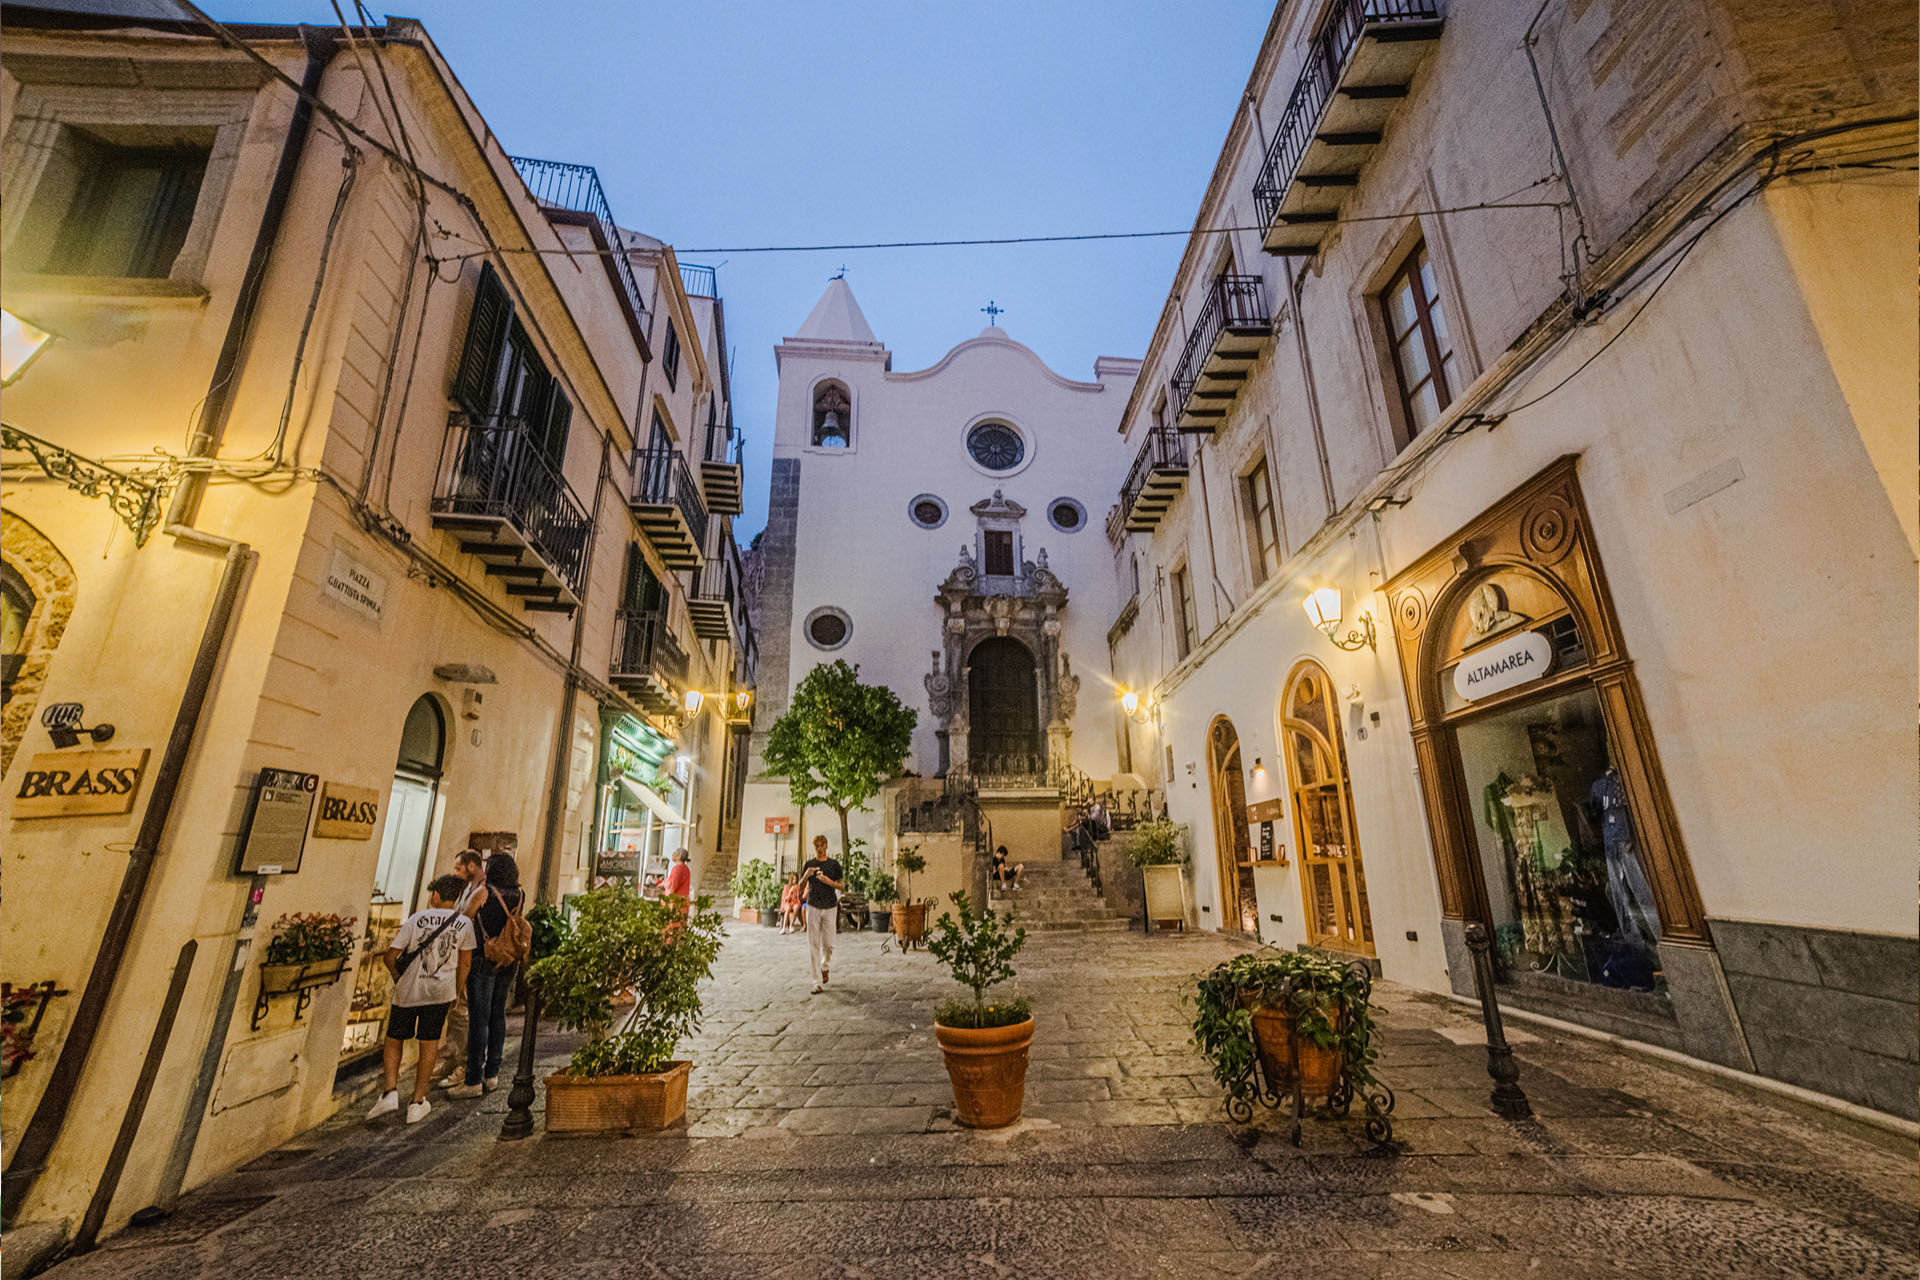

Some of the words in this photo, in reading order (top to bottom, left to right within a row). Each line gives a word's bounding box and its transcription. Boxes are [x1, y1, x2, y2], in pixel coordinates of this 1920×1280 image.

[349, 569, 370, 590] PIAZZA
[1467, 649, 1535, 686] ALTAMAREA
[16, 767, 139, 799] BRASS
[321, 795, 378, 825] BRASS
